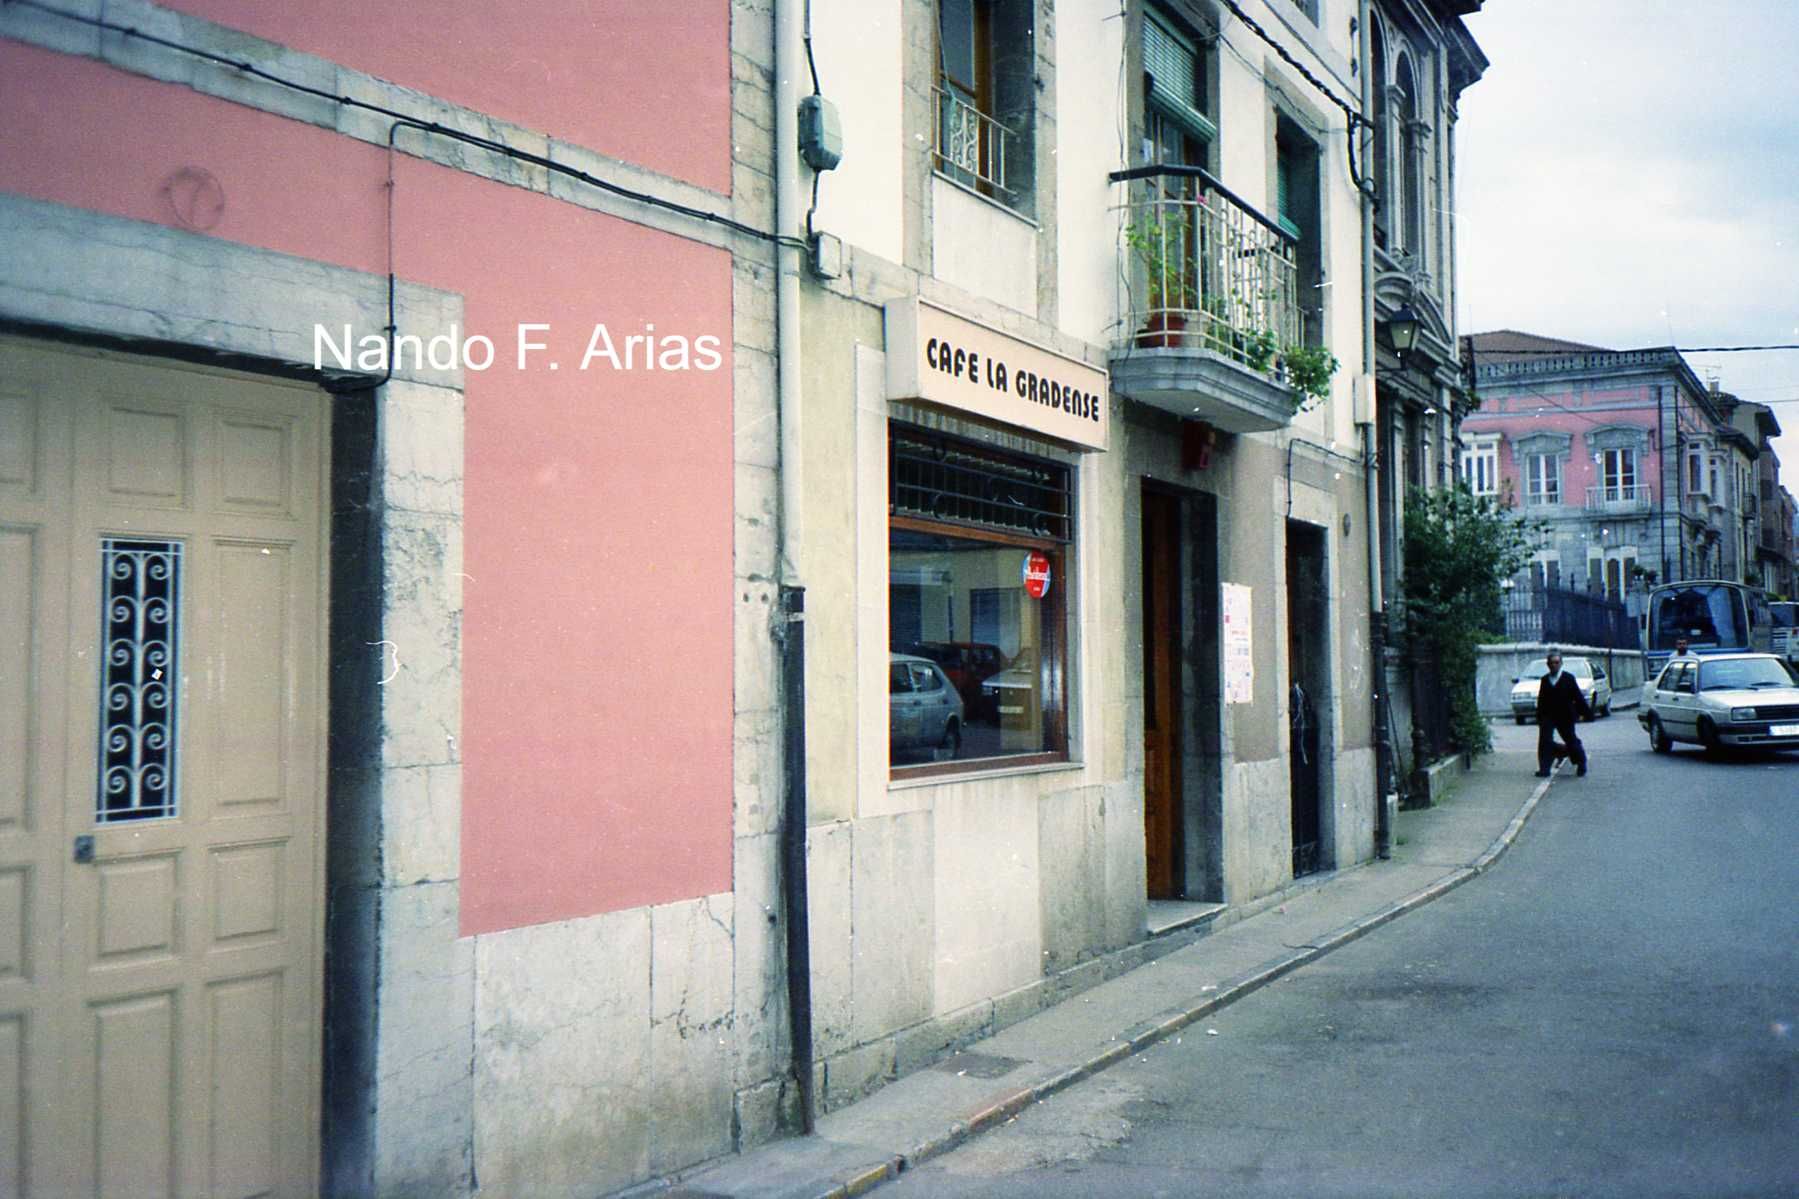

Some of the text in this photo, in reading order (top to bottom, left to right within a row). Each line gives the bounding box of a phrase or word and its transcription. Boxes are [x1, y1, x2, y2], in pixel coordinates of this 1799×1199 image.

[927, 338, 1099, 422] CAFE LA GRADENSE
